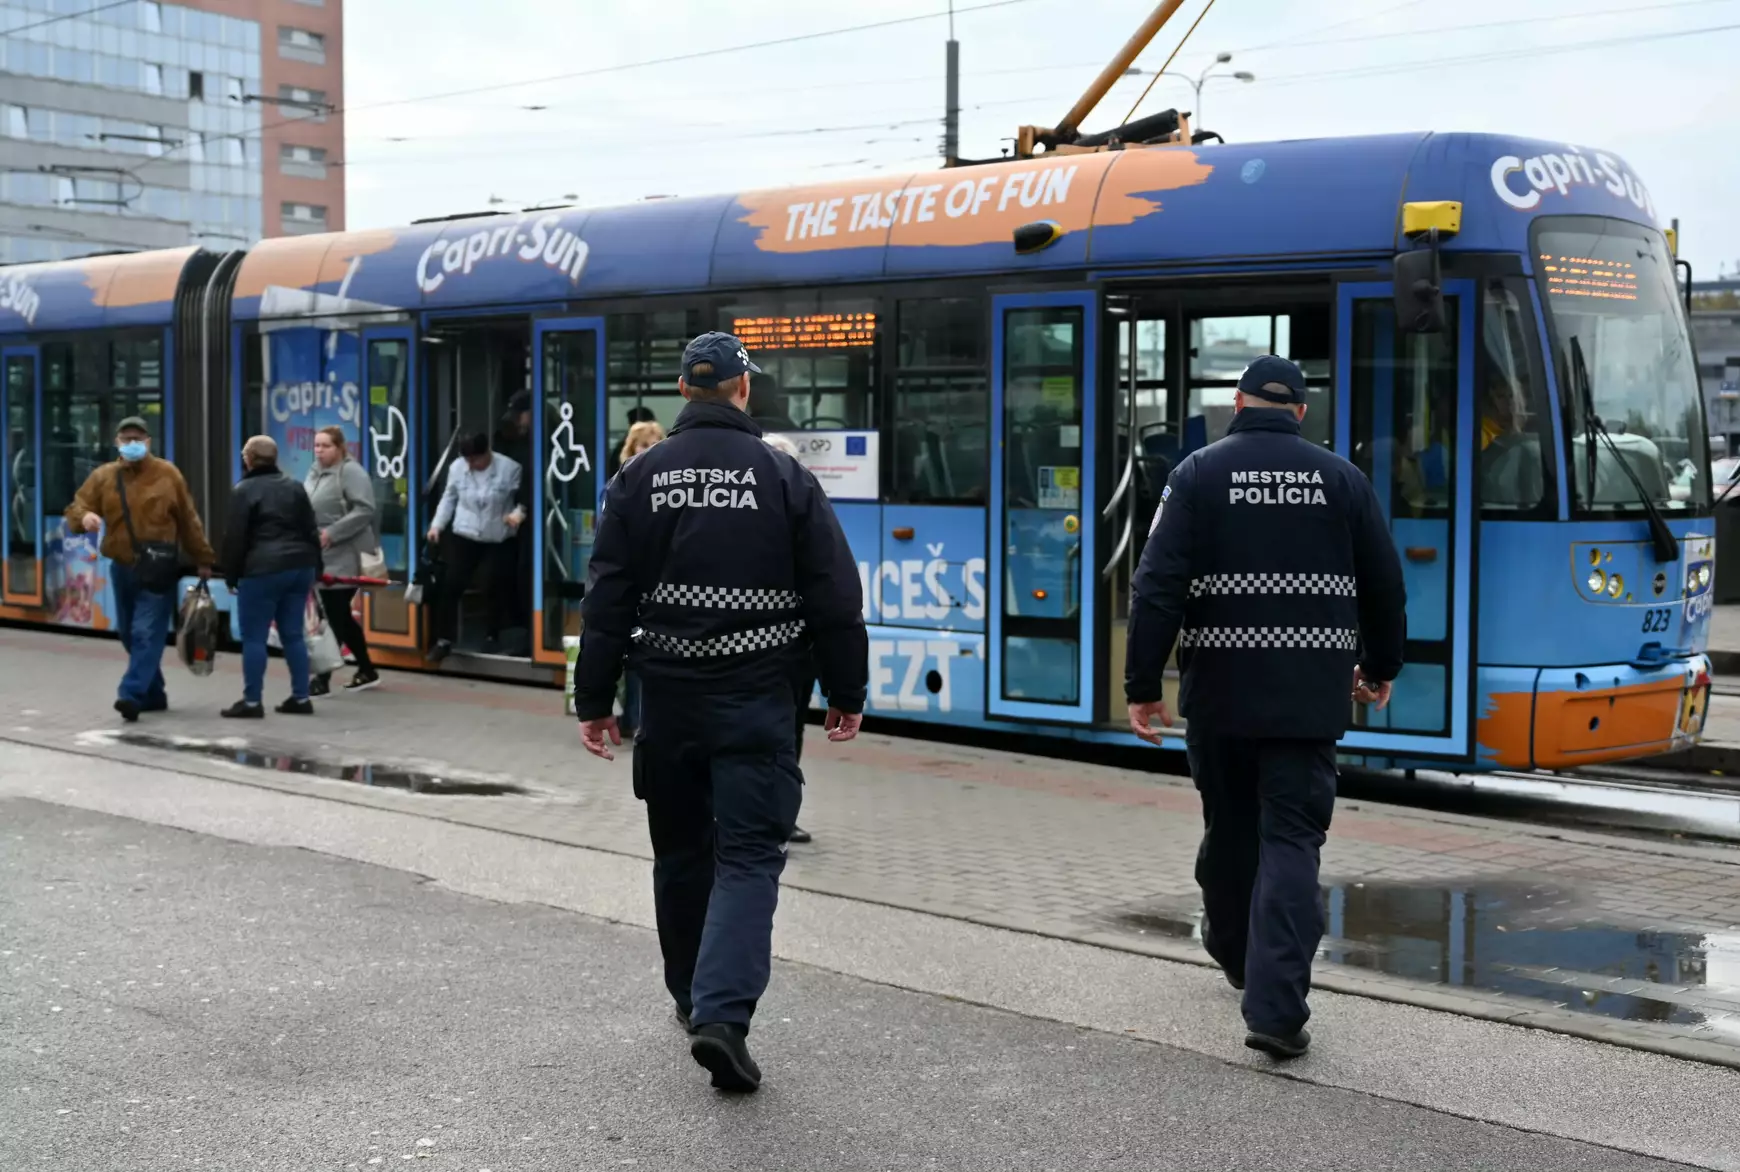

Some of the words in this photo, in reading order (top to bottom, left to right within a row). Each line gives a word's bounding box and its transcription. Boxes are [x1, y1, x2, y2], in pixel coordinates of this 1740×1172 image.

[784, 197, 844, 241] THE
[848, 184, 943, 232] TASTE
[944, 176, 999, 218] OF
[997, 165, 1078, 212] FUN
[416, 215, 590, 293] Capri-Sun
[652, 467, 757, 488] MESTSKÁ
[1231, 470, 1324, 484] MESTSKÁ
[650, 483, 759, 513] POLÍCIA
[1228, 484, 1328, 505] POLÍCIA
[1641, 608, 1672, 633] 823
